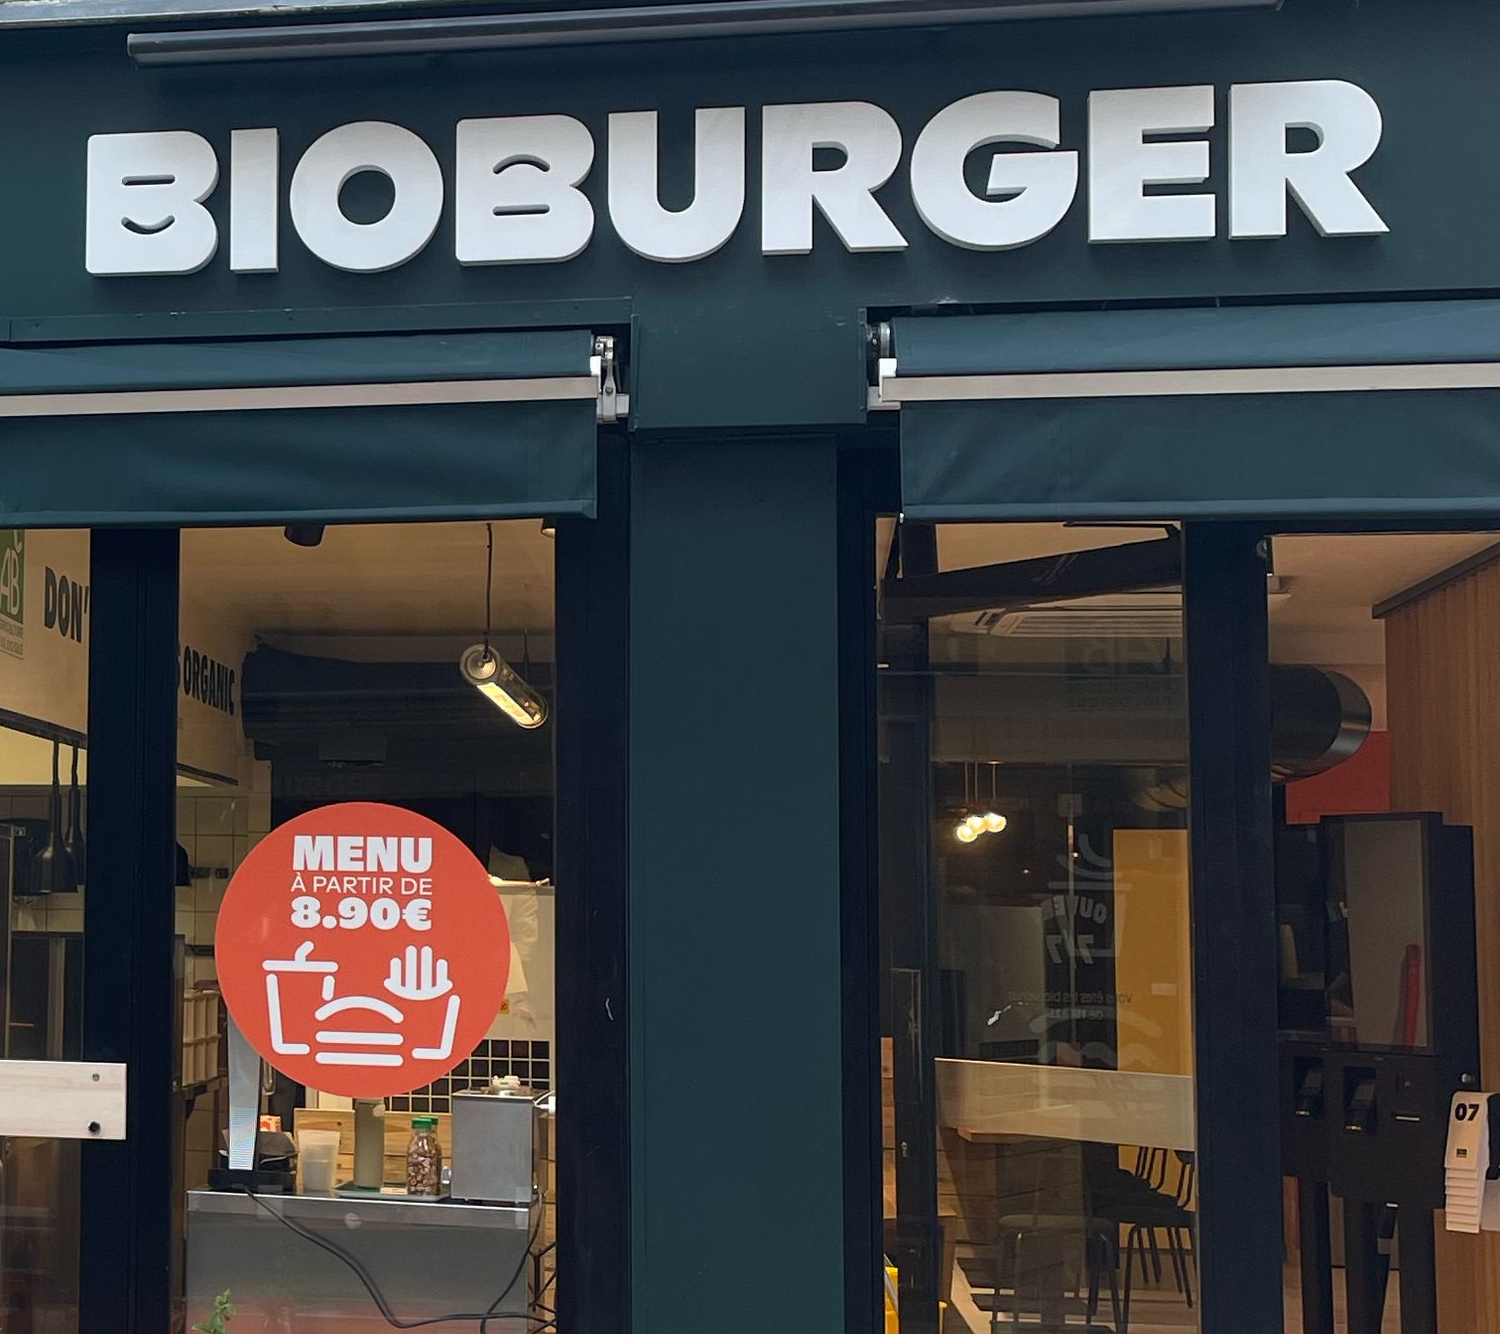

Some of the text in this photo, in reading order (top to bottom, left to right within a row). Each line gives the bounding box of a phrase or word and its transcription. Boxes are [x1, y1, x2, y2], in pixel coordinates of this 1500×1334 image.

[85, 79, 1390, 275] BIOBURGER
[183, 644, 236, 716] ORGANIC
[292, 835, 433, 873] MENU
[290, 872, 433, 895] À PARTIR DE
[290, 895, 433, 932] 8.90€
[1454, 1102, 1480, 1121] 07
